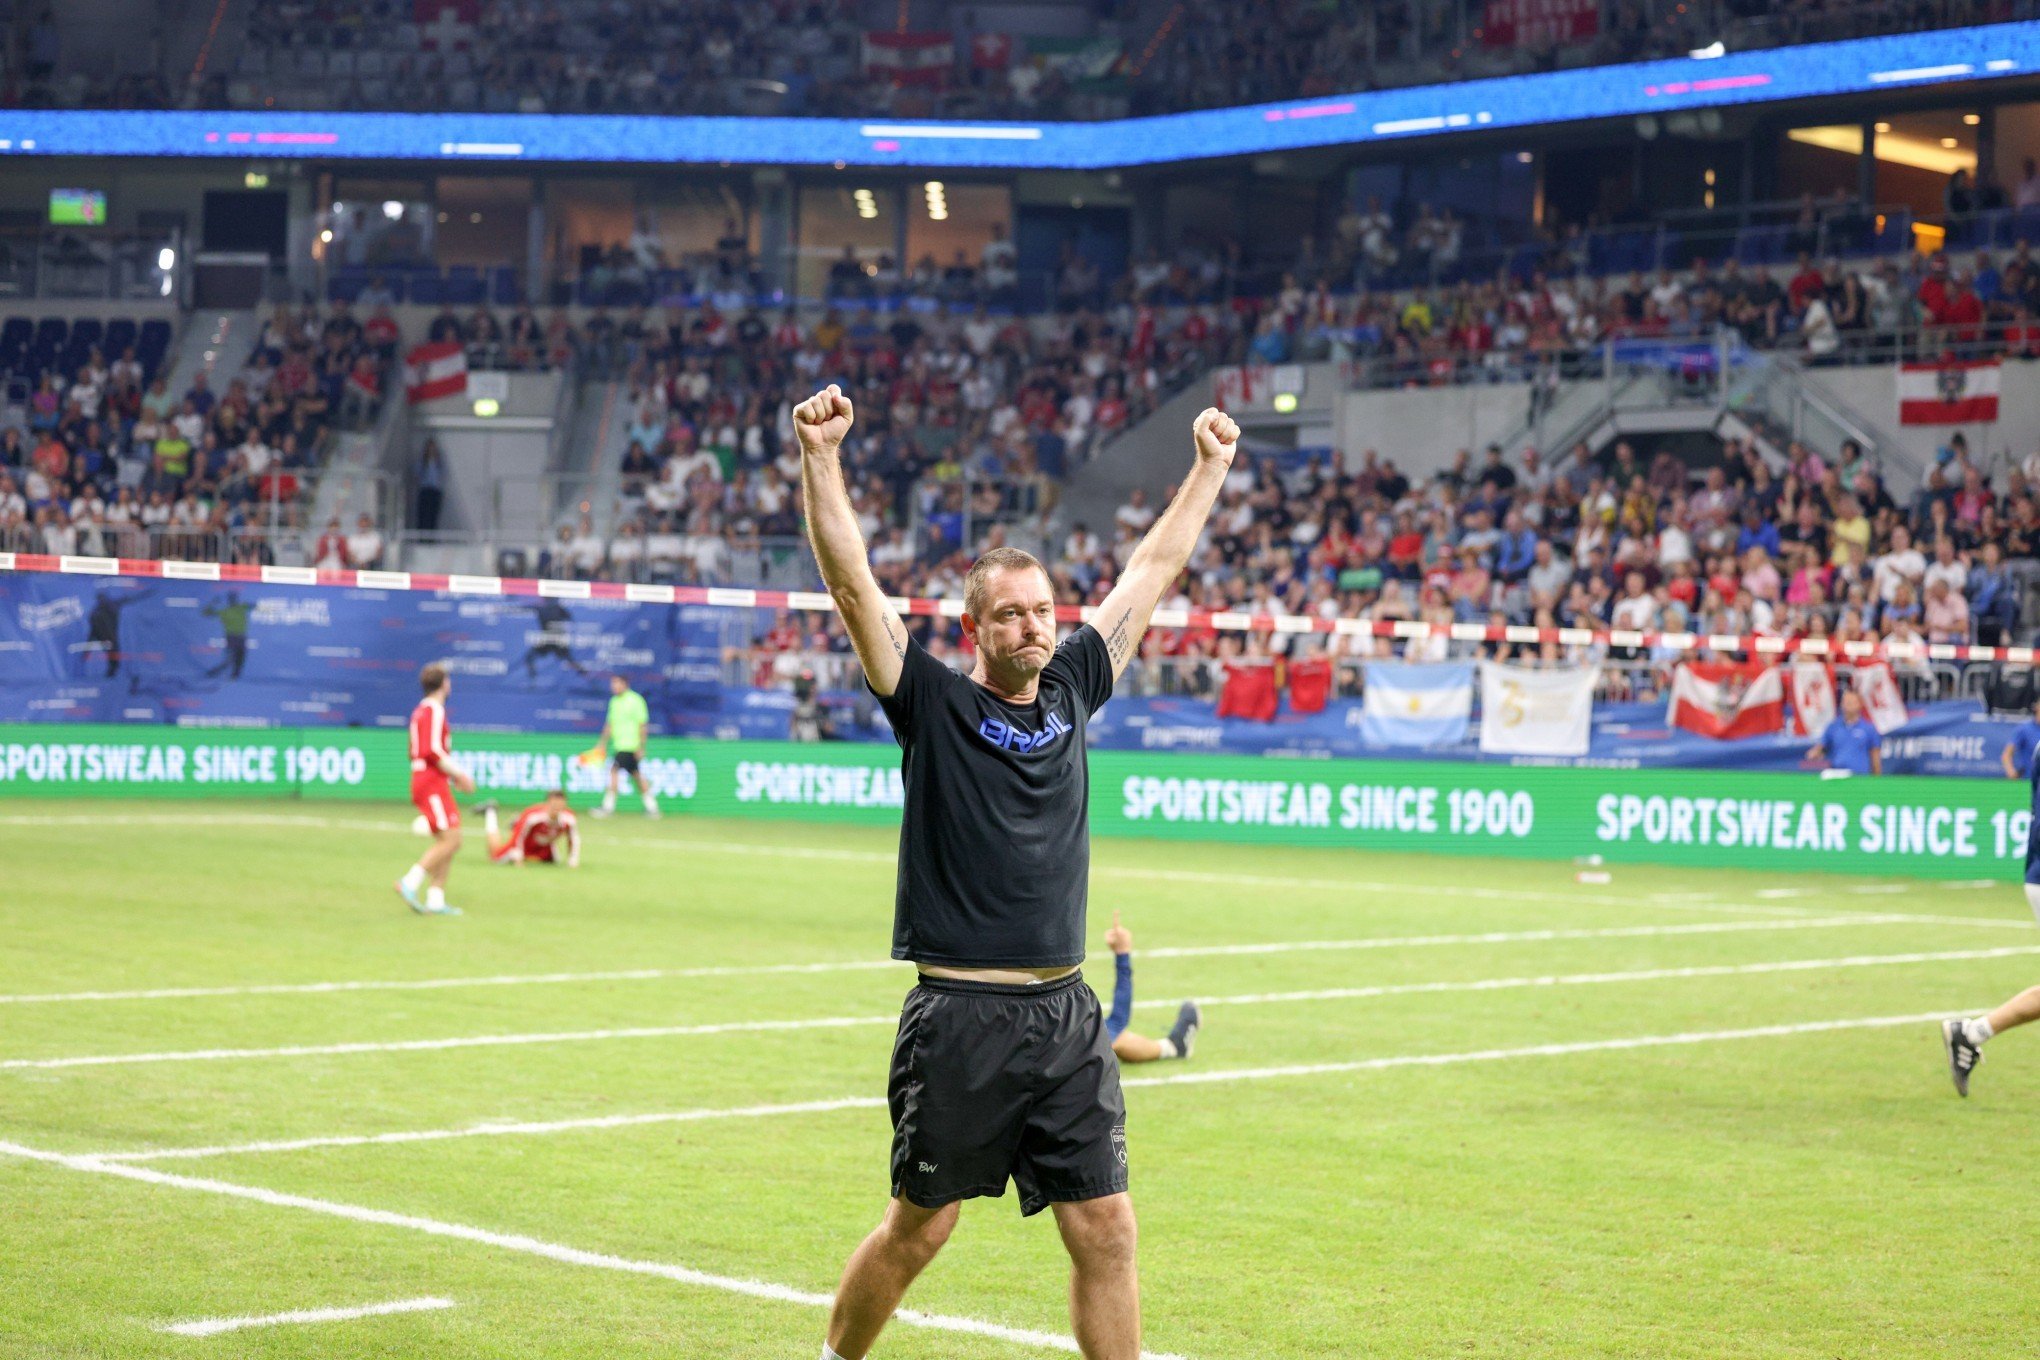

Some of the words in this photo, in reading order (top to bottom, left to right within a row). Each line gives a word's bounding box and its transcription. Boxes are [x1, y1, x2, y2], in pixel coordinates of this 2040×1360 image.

[193, 744, 277, 783] SINCE
[284, 745, 366, 786] 1900
[735, 760, 905, 809] SPORTSWEAR
[1122, 775, 1333, 828] SPORTSWEAR
[1339, 783, 1440, 833] SINCE
[1447, 788, 1534, 838] 1900
[1596, 793, 1849, 851] SPORTSWEAR
[1859, 804, 1978, 857] SINCE
[1991, 809, 2032, 860] 19
